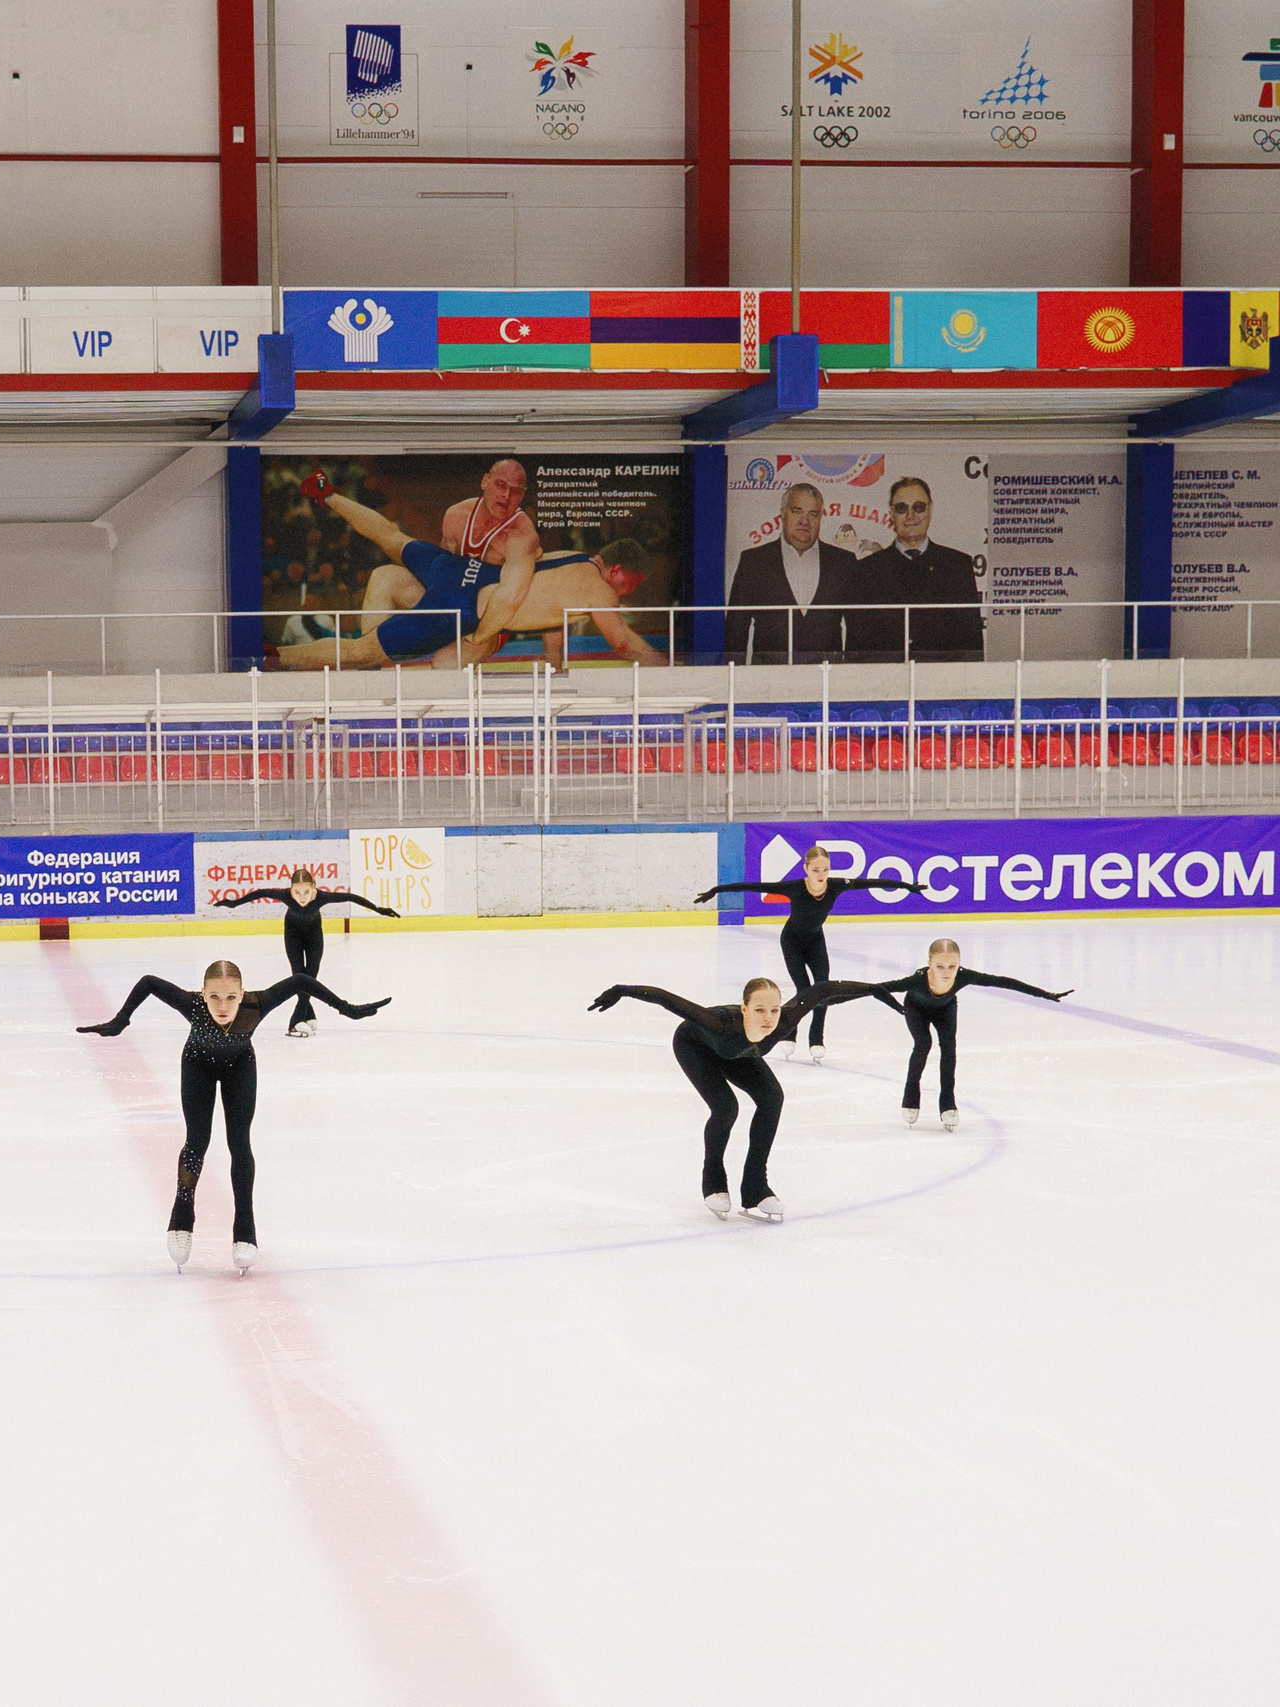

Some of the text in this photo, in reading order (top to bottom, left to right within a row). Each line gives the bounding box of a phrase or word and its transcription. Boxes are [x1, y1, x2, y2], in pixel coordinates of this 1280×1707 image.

[536, 103, 586, 114] NAGANO
[781, 105, 891, 118] SLT LAKE 2002
[962, 108, 1067, 120] torino 2006
[72, 330, 113, 357] VIP
[199, 329, 240, 357] VIP
[536, 465, 680, 478] Александр КАРЕЛИН
[1173, 469, 1261, 480] ЕПЕЛЕВ С. М.
[537, 480, 598, 488] Трехкратный
[993, 474, 1122, 486] РОМИШЕВСКИЙ И.А.
[1173, 481, 1235, 490] ЛИМПИЙСКИЙ
[537, 490, 600, 498] олимпийский
[993, 488, 1048, 496] СОВЕТСКИЙ
[1173, 492, 1229, 500] ОБЕДИТЕЛЬ,
[537, 500, 604, 509] Многократный
[993, 497, 1080, 505] ЧЕТЫРЕХКРАТНЫЙ
[1173, 501, 1232, 509] РЕХКРАТНЫЙ
[537, 510, 633, 518] мира, Европы, СССР.
[537, 520, 601, 528] Герой России
[993, 517, 1055, 525] ДВУКРАТНЫЙ
[1172, 521, 1235, 529] АСЛУЖЕННЫЙ
[993, 526, 1063, 534] ОЛИМПИЙСКИЙ
[993, 537, 1054, 545] ПОБЕДИТЕЛЬ
[461, 558, 482, 587] BUL
[993, 567, 1051, 577] ГОЛУБЕВ
[1173, 563, 1251, 574] ОЛУБЕВ В.А.
[993, 579, 1063, 587] ЗАСЛУЖЕННЫЙ
[1172, 575, 1235, 584] АСЛУЖЕННЫЙ
[1029, 589, 1068, 597] РОССИИ,
[992, 608, 1005, 616] СК
[360, 834, 398, 871] TOP
[27, 849, 140, 869] Федерация
[816, 840, 1275, 904] Ростелеком
[102, 869, 180, 885] катания
[20, 890, 100, 906] коньках
[106, 887, 178, 903] России
[363, 874, 432, 912] CHIPS
